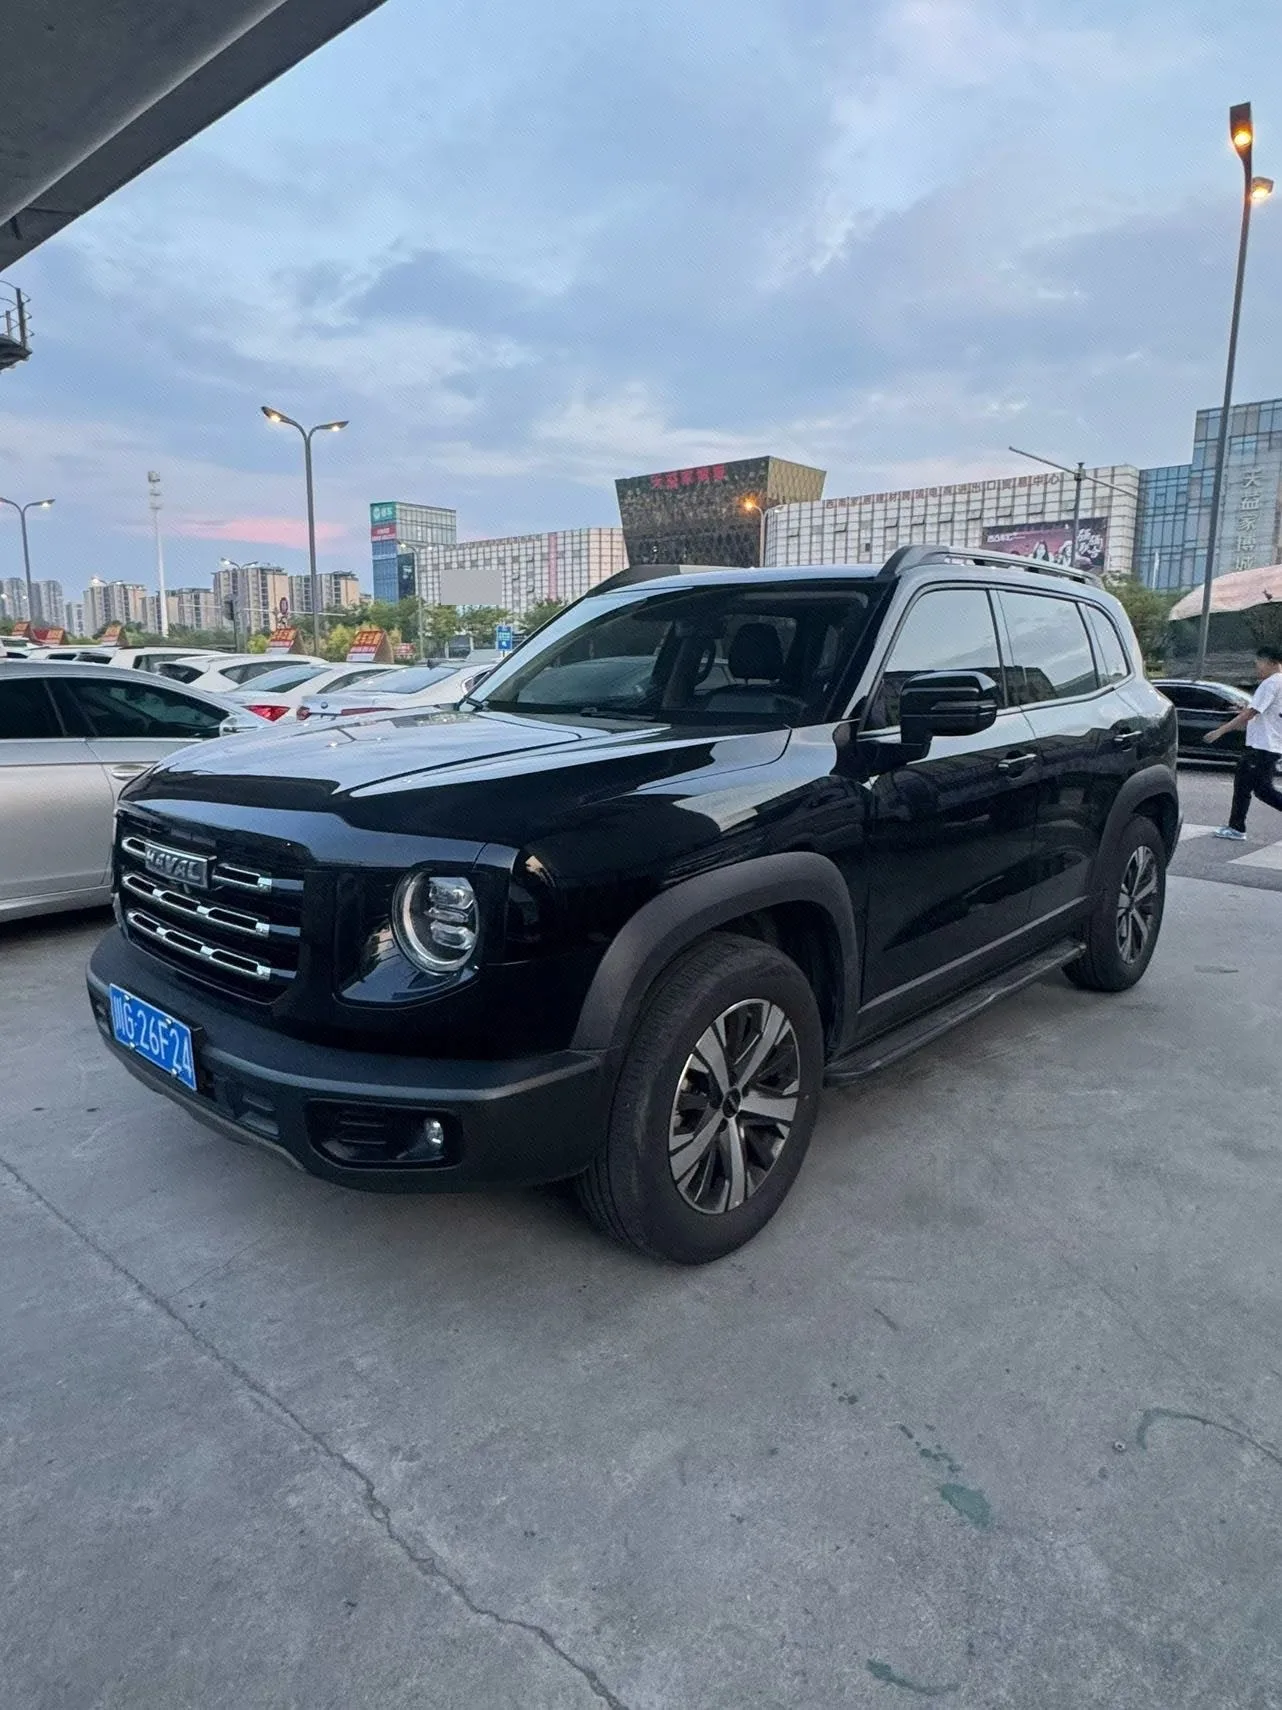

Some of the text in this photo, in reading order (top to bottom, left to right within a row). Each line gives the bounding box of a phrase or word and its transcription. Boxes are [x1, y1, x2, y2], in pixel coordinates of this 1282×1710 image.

[1236, 470, 1263, 571] 天益家博城
[146, 850, 201, 880] HAVAL
